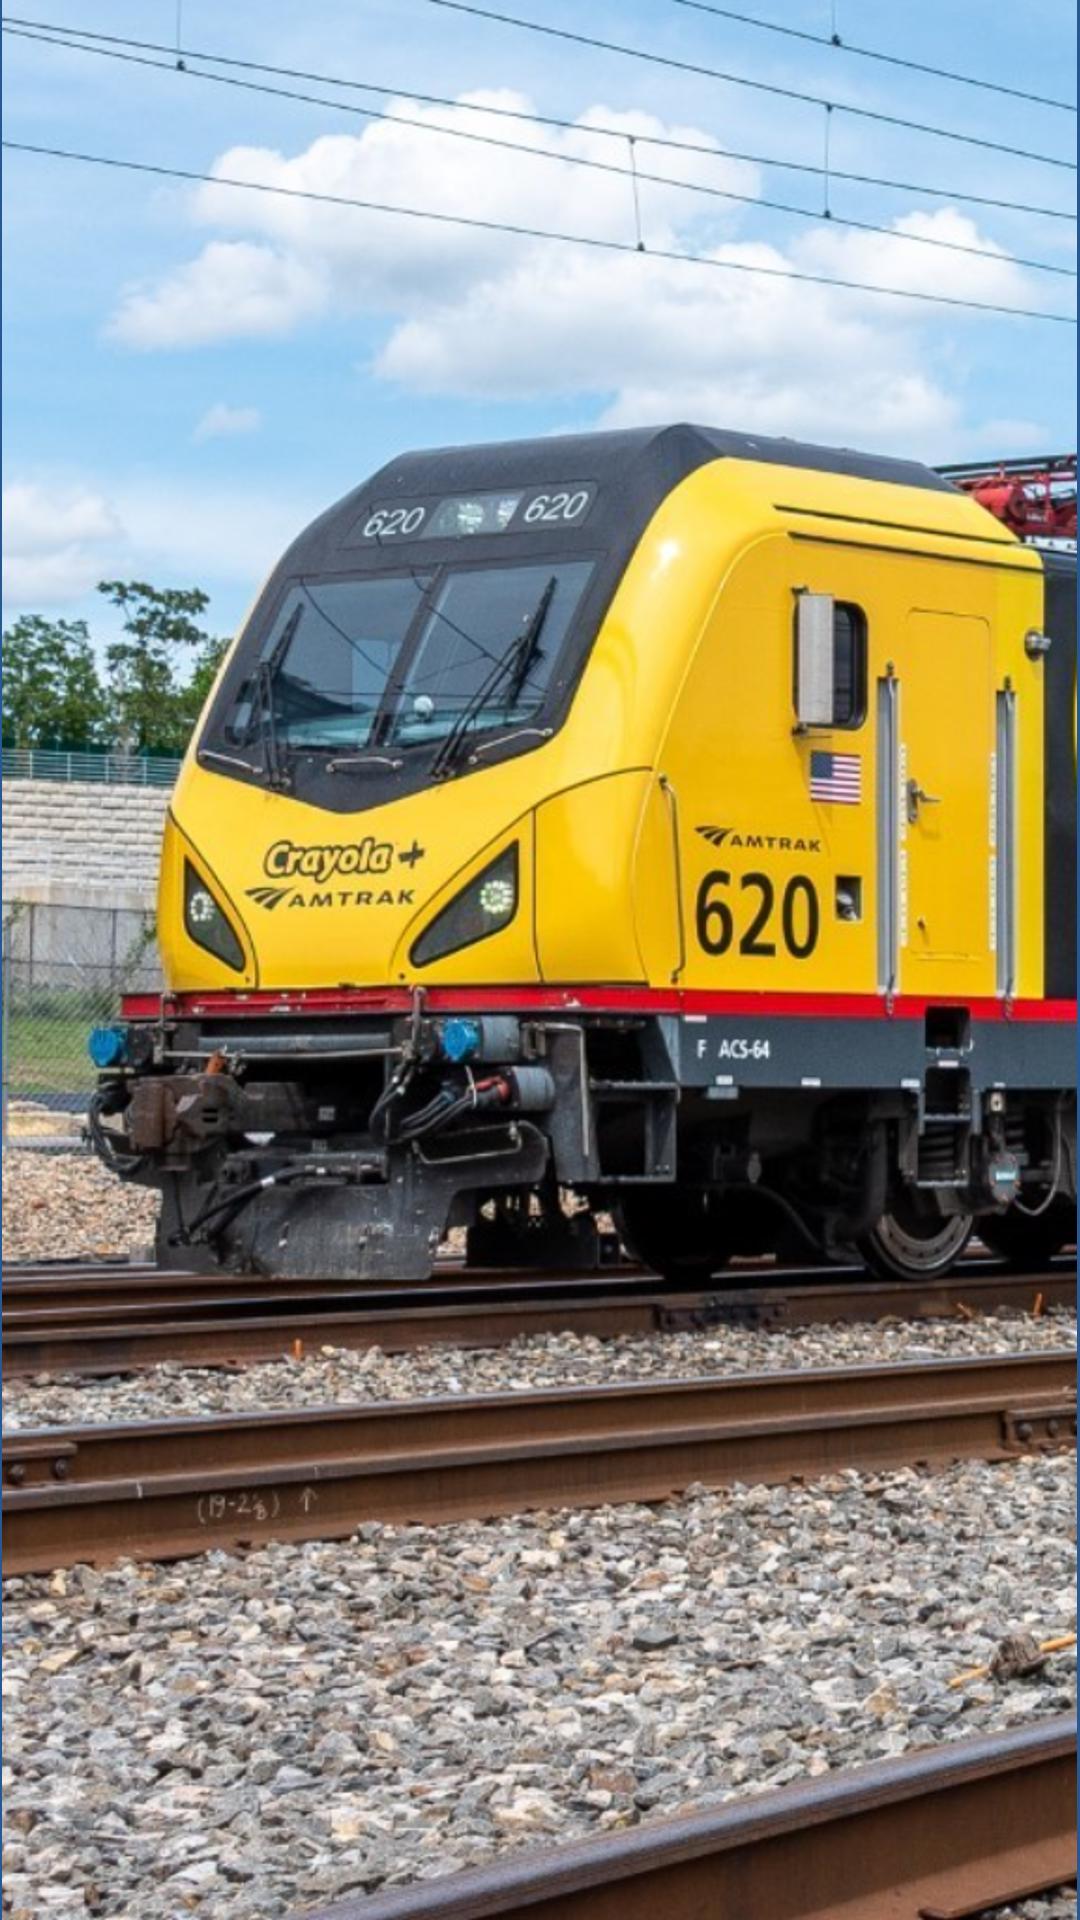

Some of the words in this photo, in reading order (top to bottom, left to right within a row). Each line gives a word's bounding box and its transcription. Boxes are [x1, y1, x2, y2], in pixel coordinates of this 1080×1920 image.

[363, 507, 425, 537] 620
[523, 491, 589, 523] 620
[730, 834, 821, 853] AMTRAK
[263, 837, 394, 884] Crayola
[288, 889, 416, 908] AMTRAK
[696, 869, 819, 960] 620
[697, 1039, 707, 1058] F
[718, 1039, 770, 1059] ACS-64
